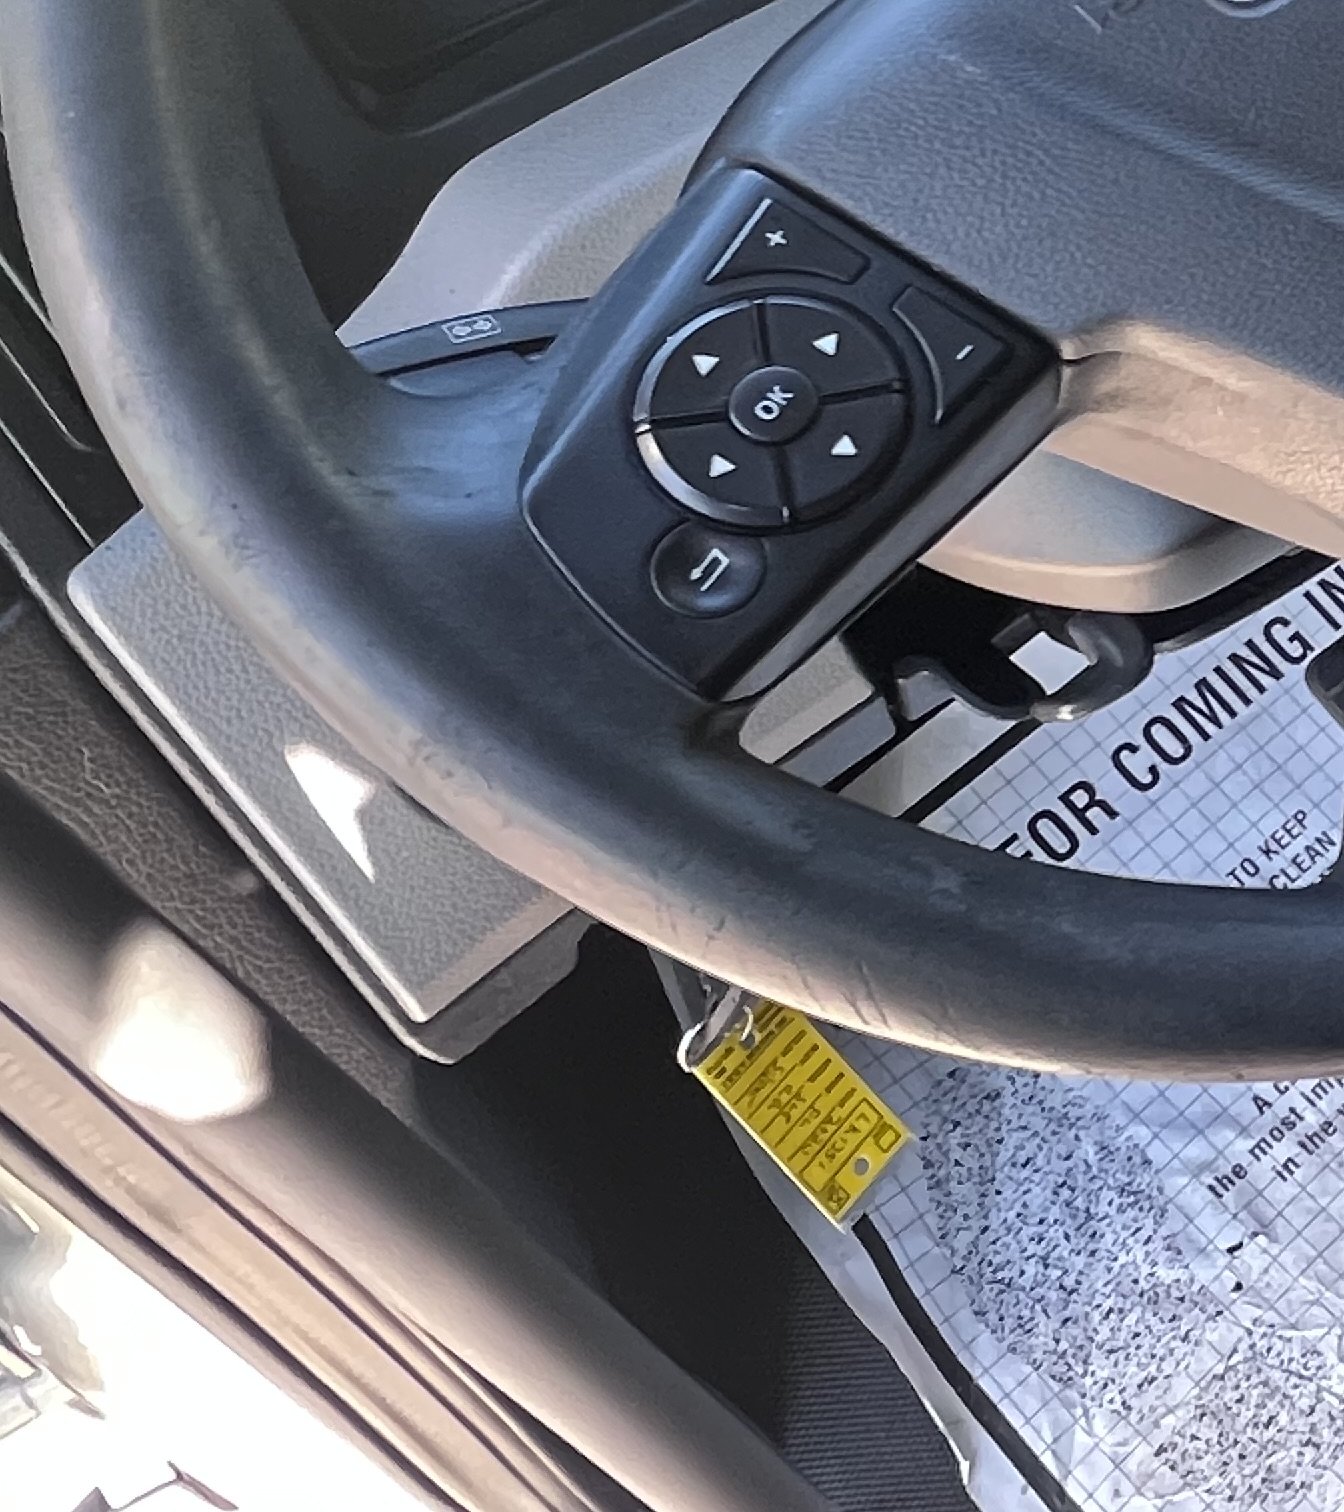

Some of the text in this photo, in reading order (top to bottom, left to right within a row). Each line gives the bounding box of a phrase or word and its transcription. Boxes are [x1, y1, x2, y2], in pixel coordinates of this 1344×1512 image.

[752, 384, 796, 422] OK
[1110, 615, 1316, 793] COMING
[1225, 808, 1308, 888] TO KEEP
[1267, 829, 1337, 890] CLEAN
[1252, 1093, 1274, 1116] A
[1206, 1105, 1305, 1200] the most
[1271, 1155, 1302, 1183] in
[1297, 1119, 1338, 1156] the
